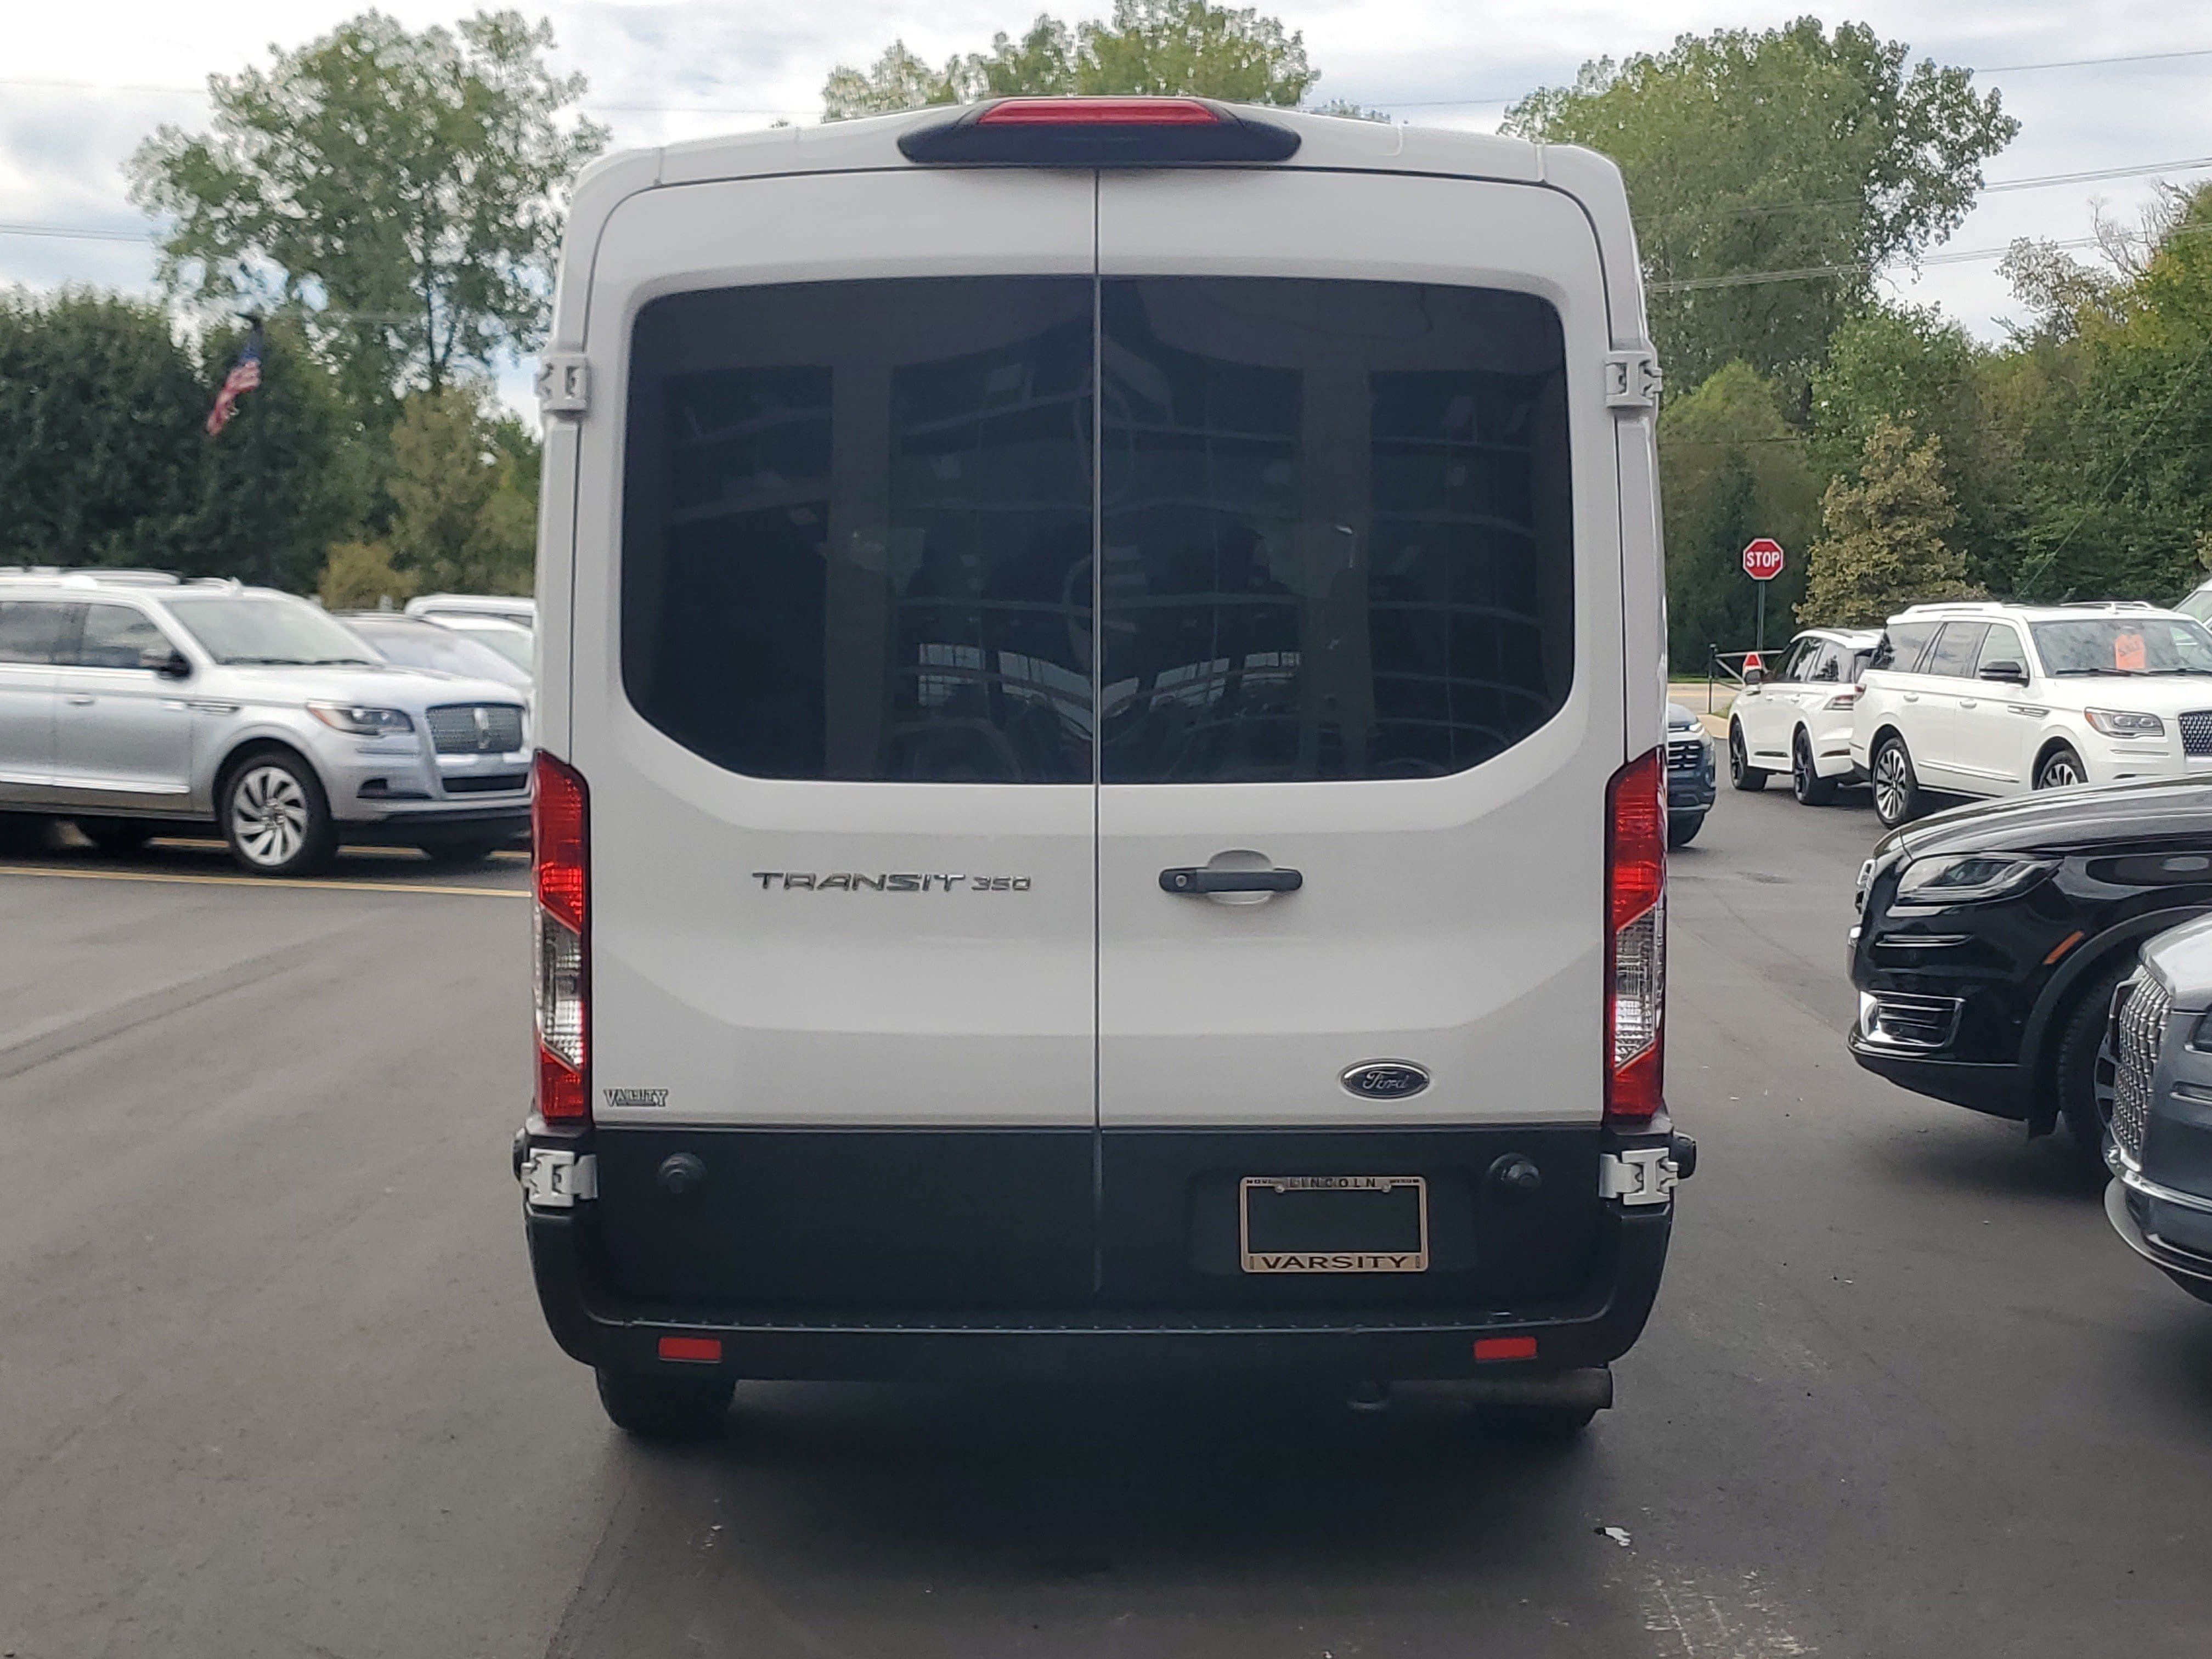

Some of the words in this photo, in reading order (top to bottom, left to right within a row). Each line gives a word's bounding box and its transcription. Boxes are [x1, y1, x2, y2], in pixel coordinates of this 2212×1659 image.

[1746, 551, 1780, 567] STOP
[752, 872, 966, 891] TRANSIT
[971, 877, 1030, 891] 350
[1363, 1071, 1409, 1089] Ford
[1290, 1178, 1375, 1188] LINCOLN
[1262, 1256, 1408, 1268] VARSITY
